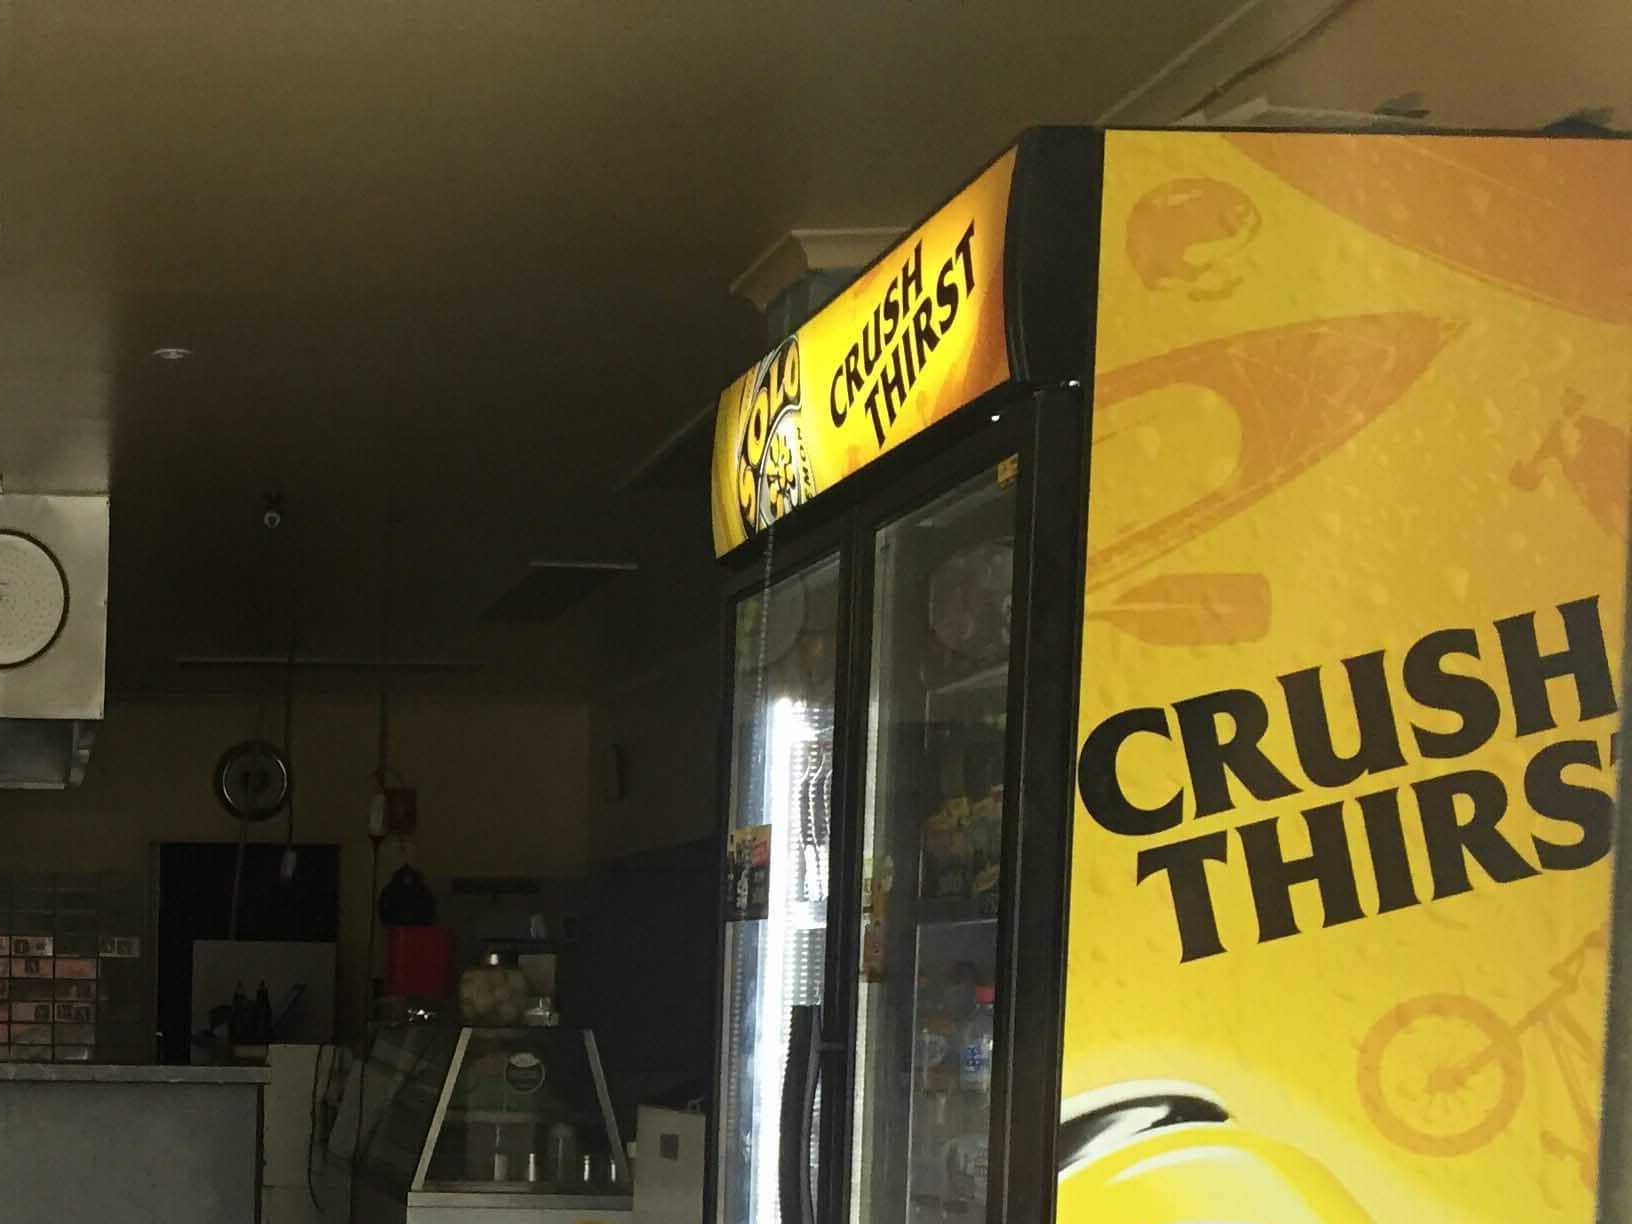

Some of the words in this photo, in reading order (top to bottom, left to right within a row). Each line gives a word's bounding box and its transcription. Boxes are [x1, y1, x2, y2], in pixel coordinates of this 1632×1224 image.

[830, 241, 924, 427] CRUSH
[865, 219, 976, 448] THIRST
[1078, 595, 1619, 836] CRUSH
[1137, 733, 1619, 966] THIRS
